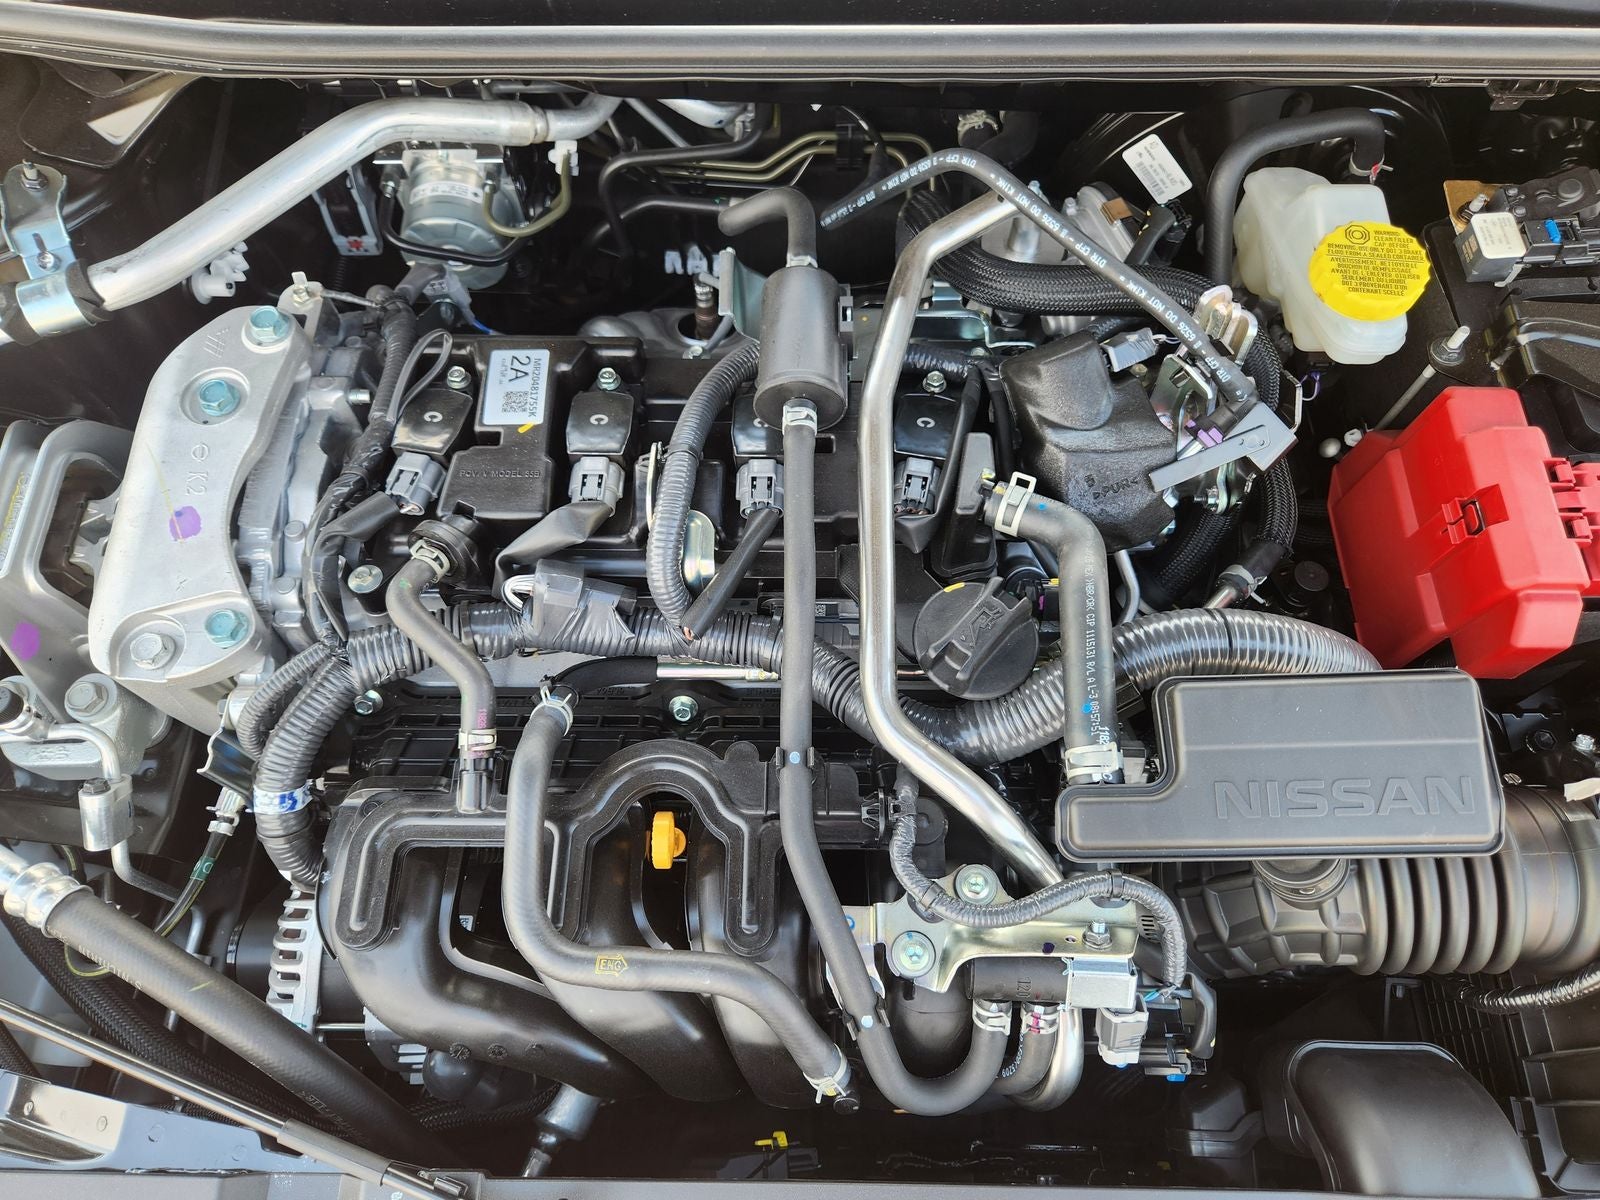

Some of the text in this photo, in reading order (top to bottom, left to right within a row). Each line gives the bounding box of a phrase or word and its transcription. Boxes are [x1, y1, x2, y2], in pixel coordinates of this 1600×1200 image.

[1013, 193, 1030, 208] NOT
[1029, 204, 1041, 217] DO
[1126, 281, 1147, 298] KINK
[1146, 296, 1165, 312] NOT
[1164, 310, 1178, 323] DO
[1176, 321, 1196, 341] 6526
[508, 355, 531, 382] 2A
[1213, 775, 1476, 819] NISSAN
